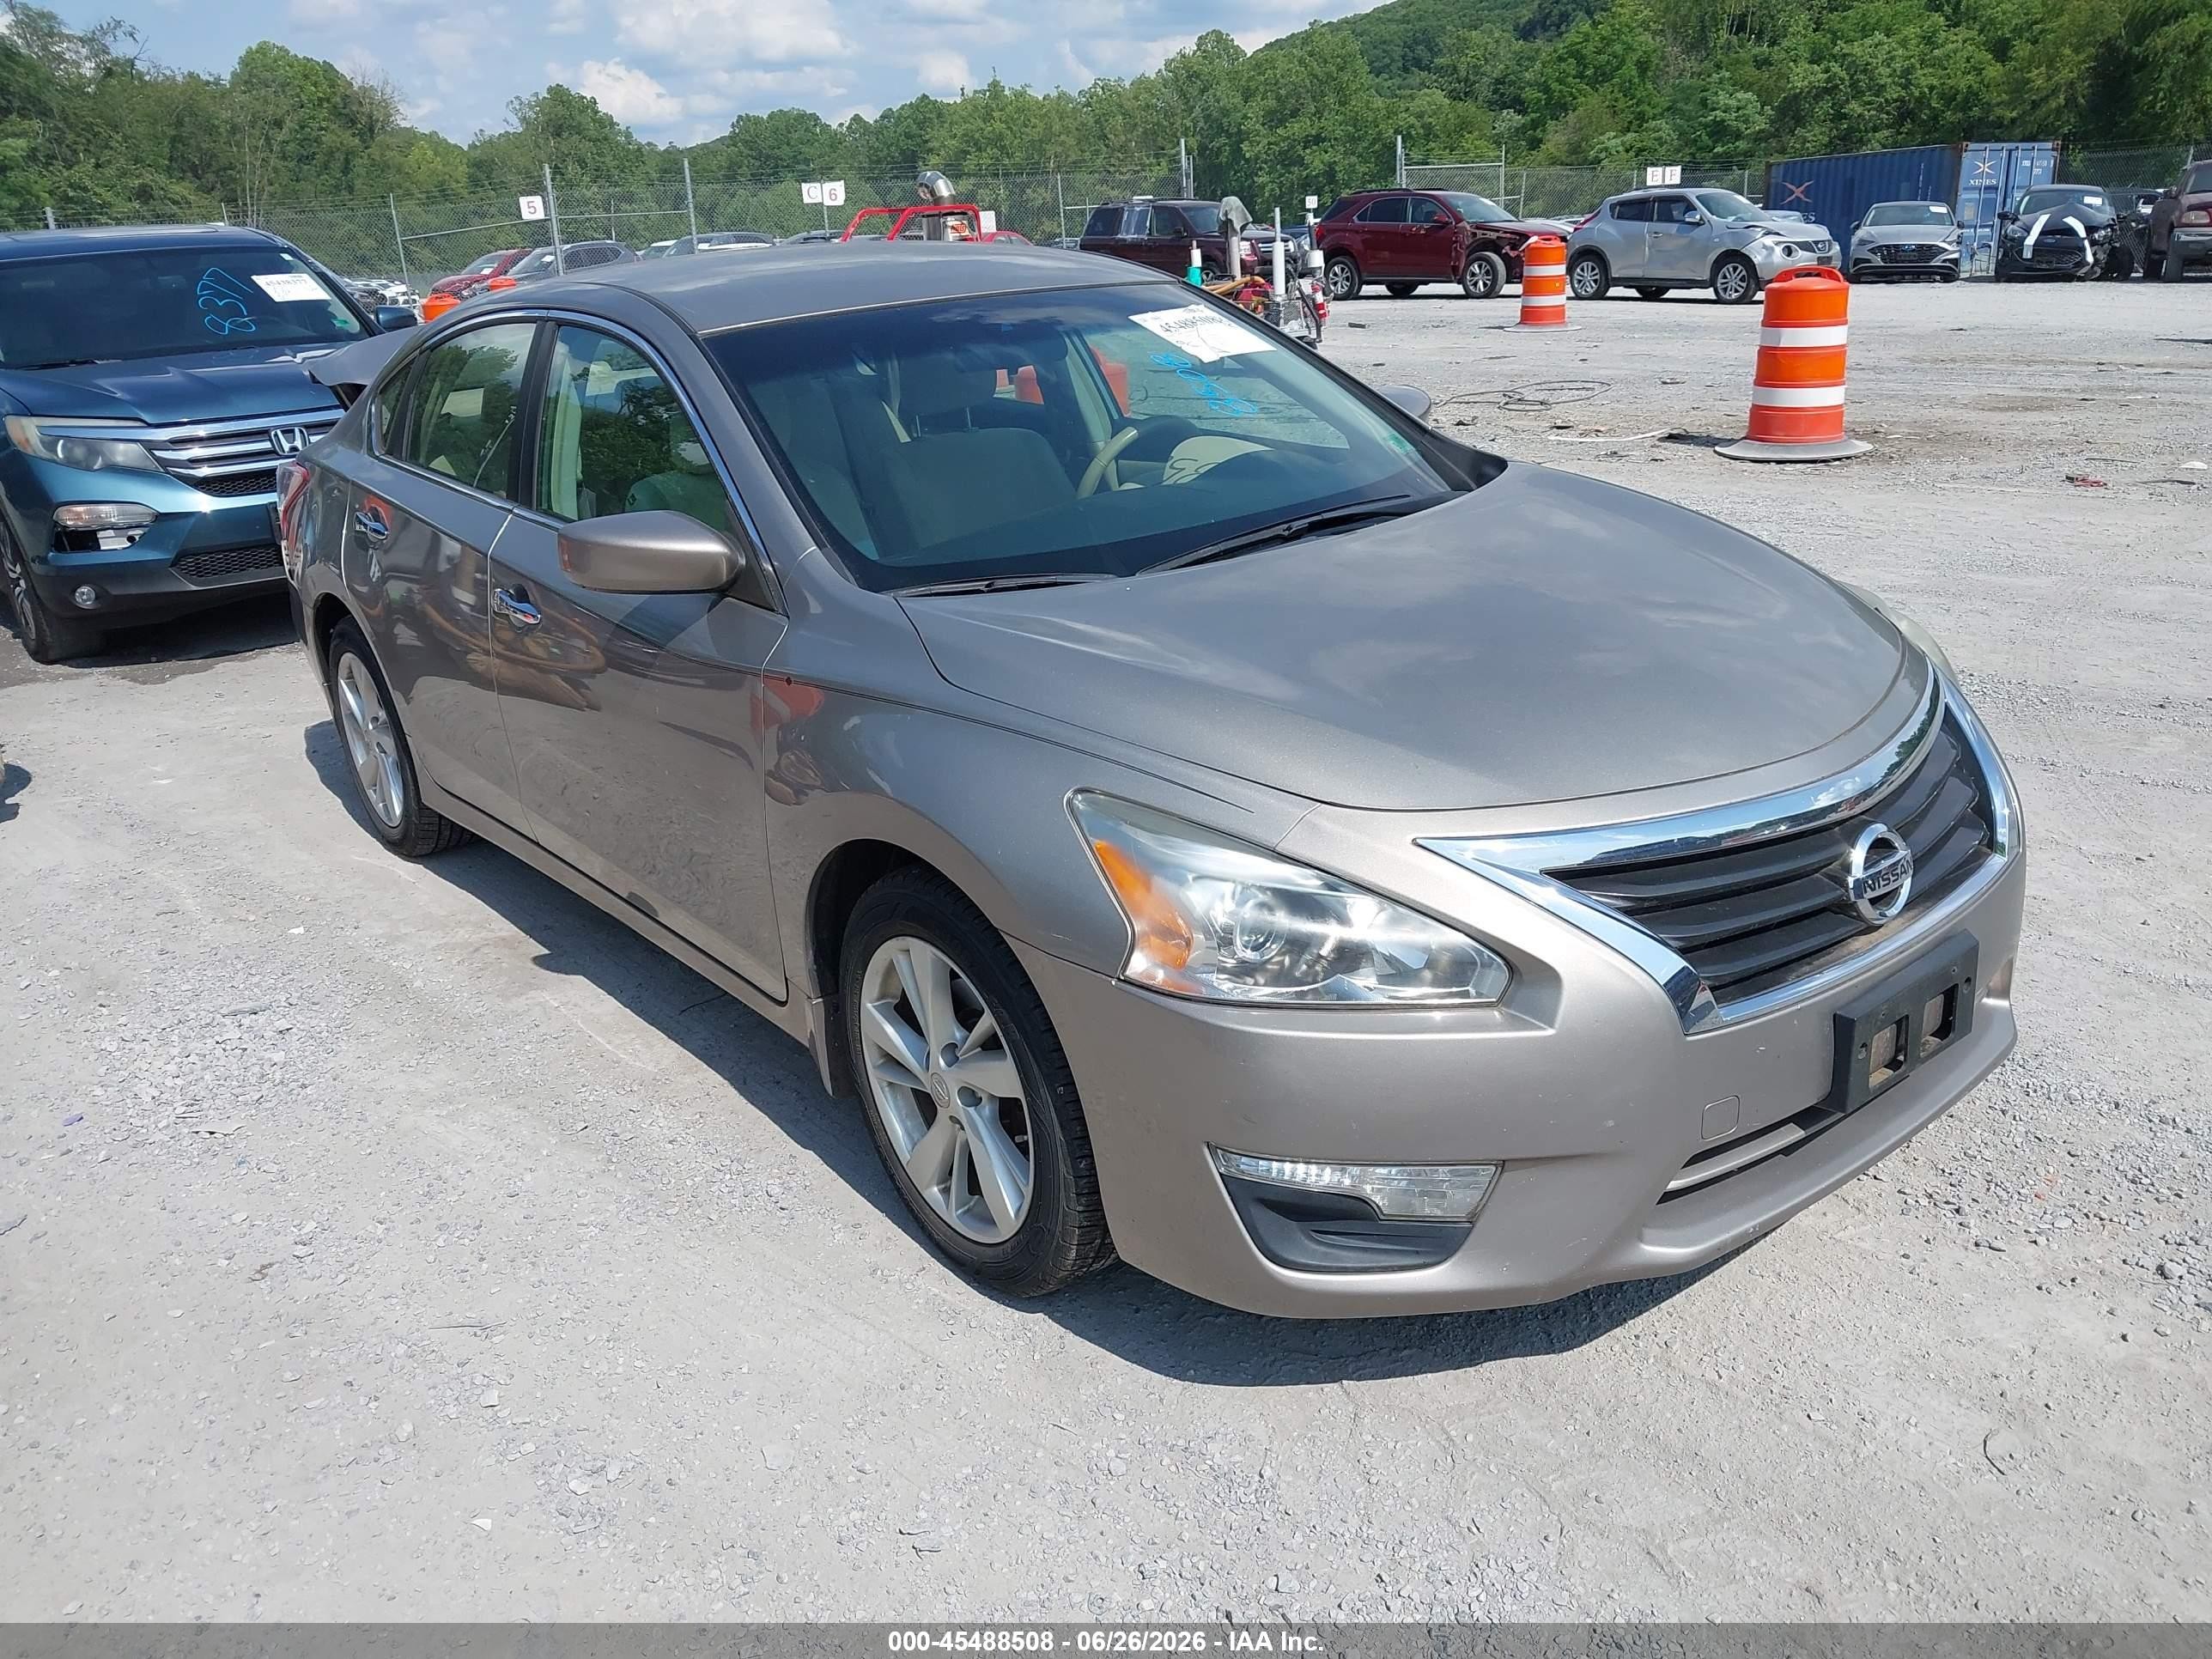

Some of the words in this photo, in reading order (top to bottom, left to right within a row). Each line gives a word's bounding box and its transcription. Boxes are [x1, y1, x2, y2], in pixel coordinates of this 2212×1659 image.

[807, 185, 818, 200] C
[829, 187, 838, 202] 6
[526, 200, 538, 215] 5
[1307, 198, 1316, 207] 50
[1863, 857, 1913, 894] NISSAN
